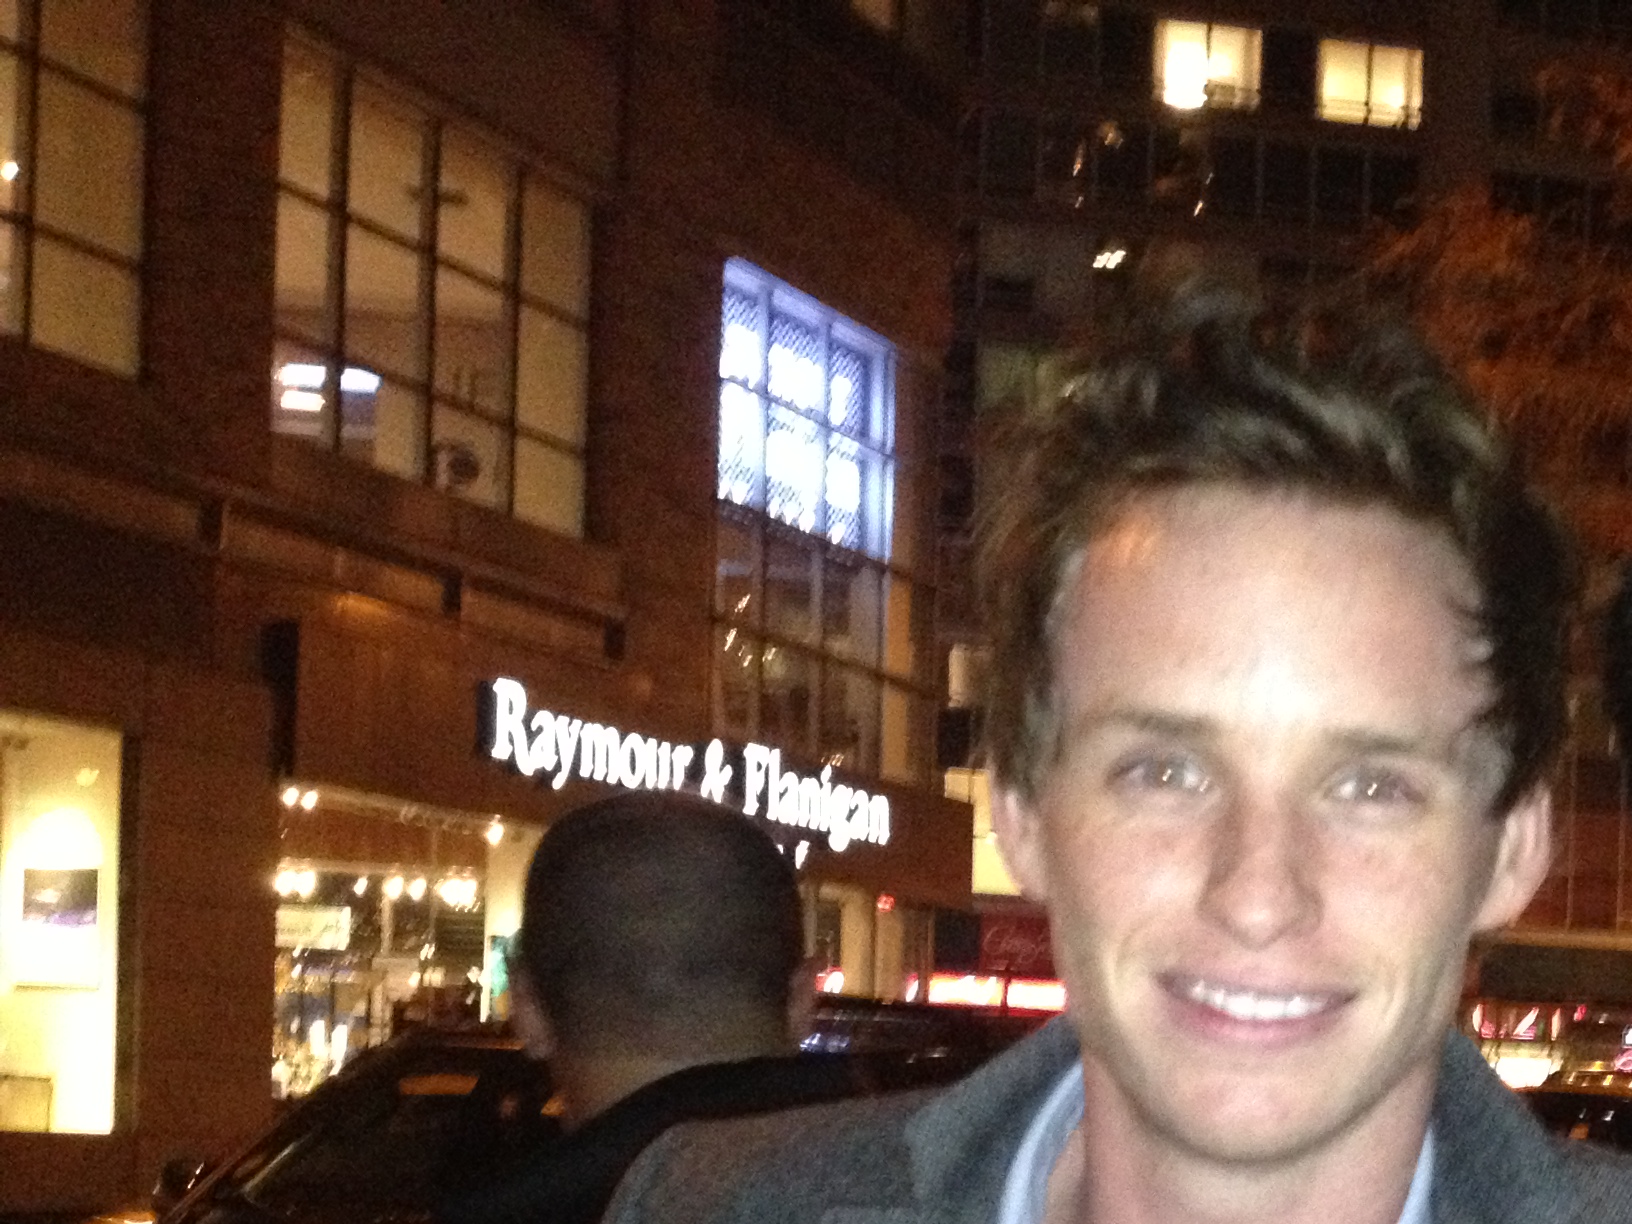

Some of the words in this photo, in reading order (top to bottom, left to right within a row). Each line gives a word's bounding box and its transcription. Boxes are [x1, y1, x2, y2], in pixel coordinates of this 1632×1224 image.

[490, 677, 695, 792] Raymour
[700, 738, 734, 804] &
[742, 742, 891, 853] Flanigan
